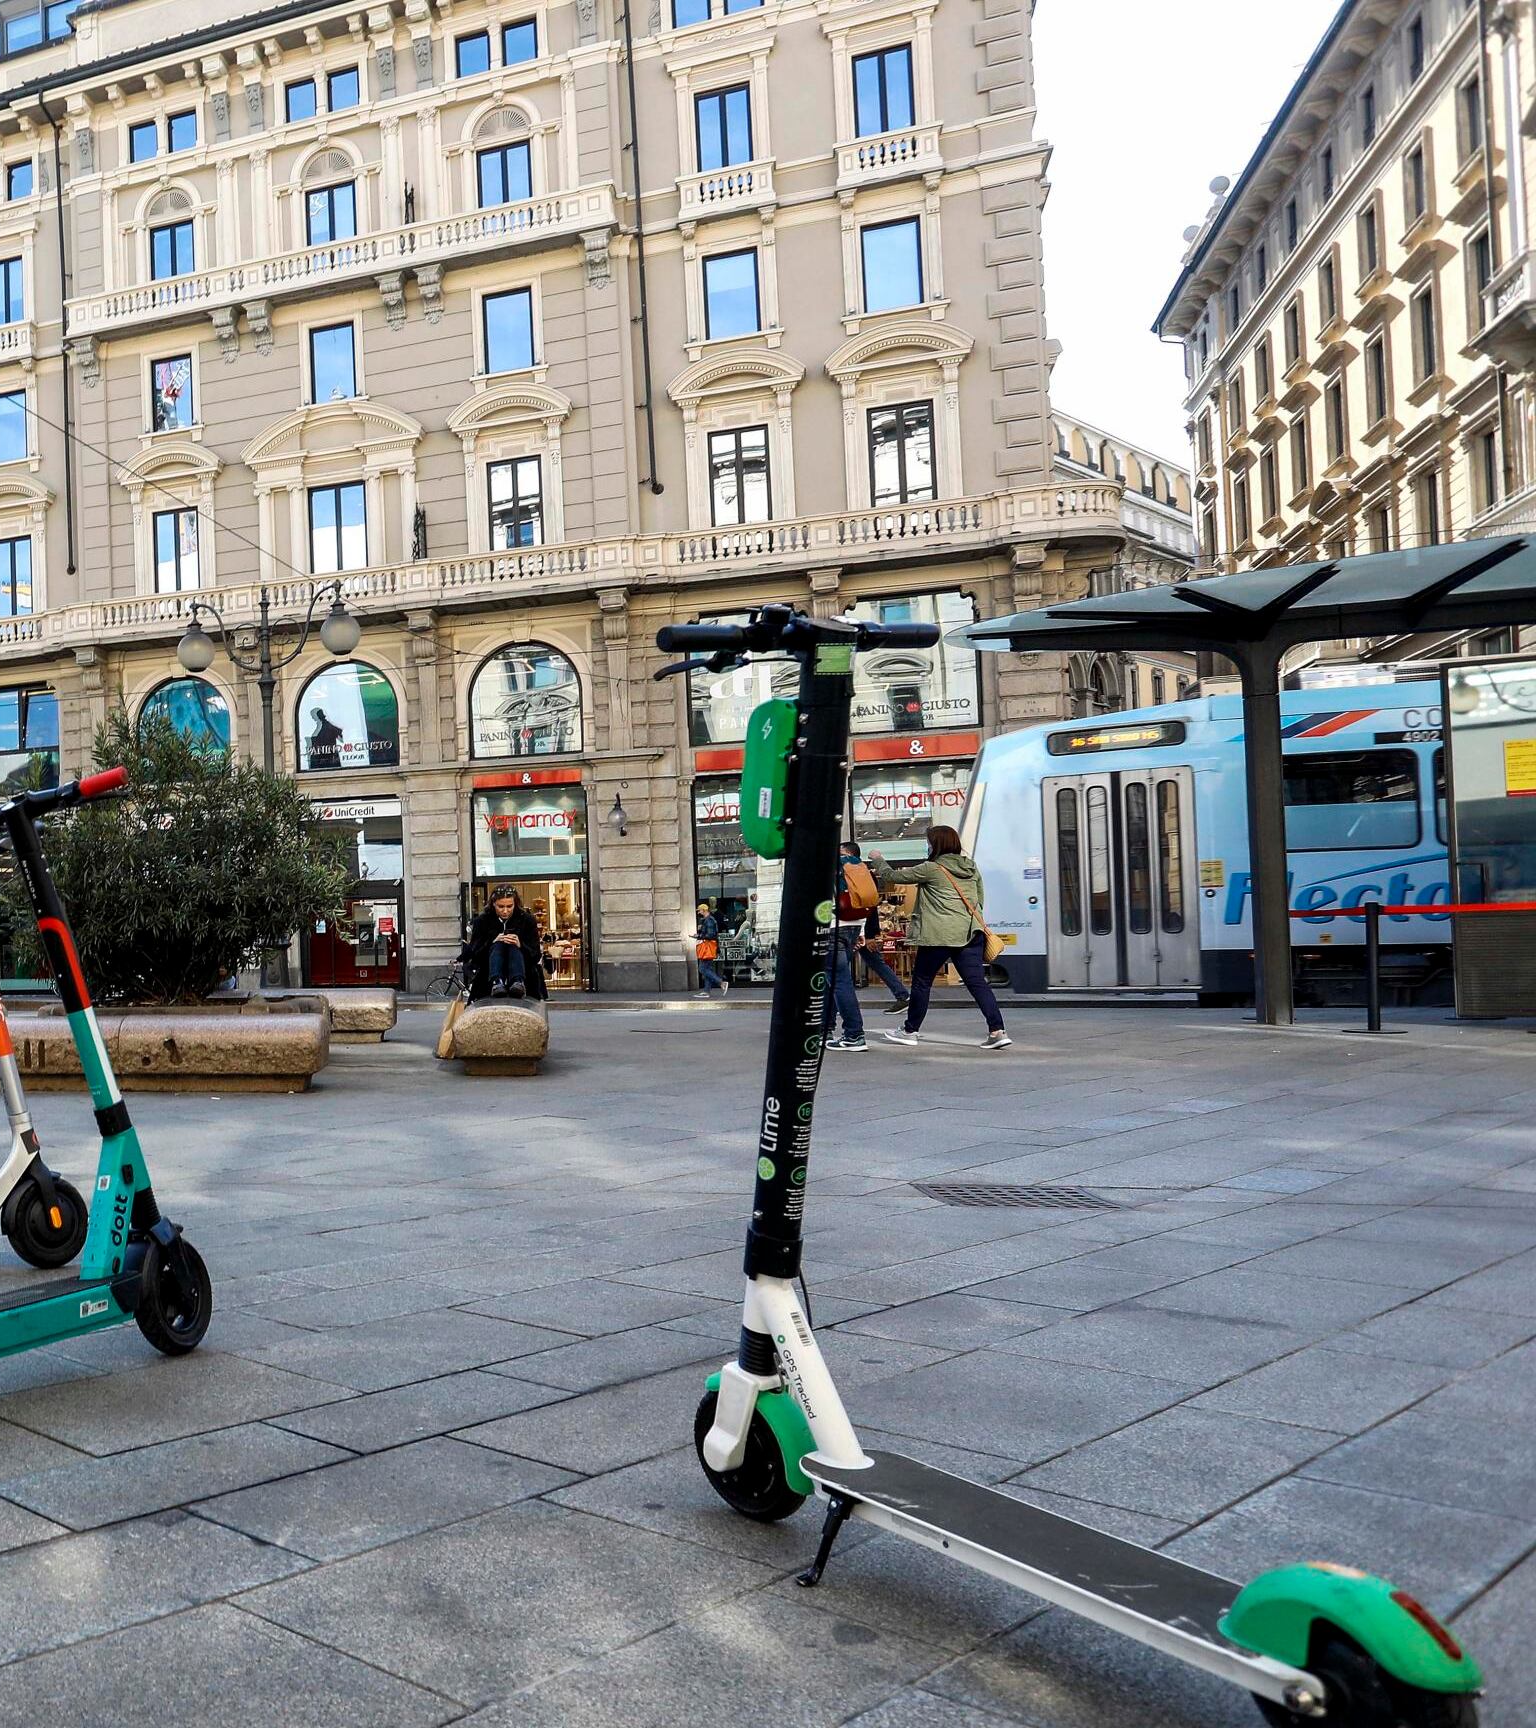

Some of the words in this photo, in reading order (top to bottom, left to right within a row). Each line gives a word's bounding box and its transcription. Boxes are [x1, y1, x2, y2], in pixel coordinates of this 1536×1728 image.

[920, 698, 971, 711] GIUSTO
[1402, 730, 1441, 743] 4902
[354, 740, 393, 752] GIUSTO
[909, 740, 924, 754] &
[521, 773, 532, 784] &
[334, 805, 375, 817] UniCredit
[483, 808, 577, 833] yamamay
[1224, 872, 1452, 925] Fecto
[816, 926, 830, 935] Lim
[760, 1096, 781, 1151] Lime
[110, 1192, 130, 1248] dott
[782, 1349, 798, 1373] GPS
[794, 1374, 818, 1420] Tracked
